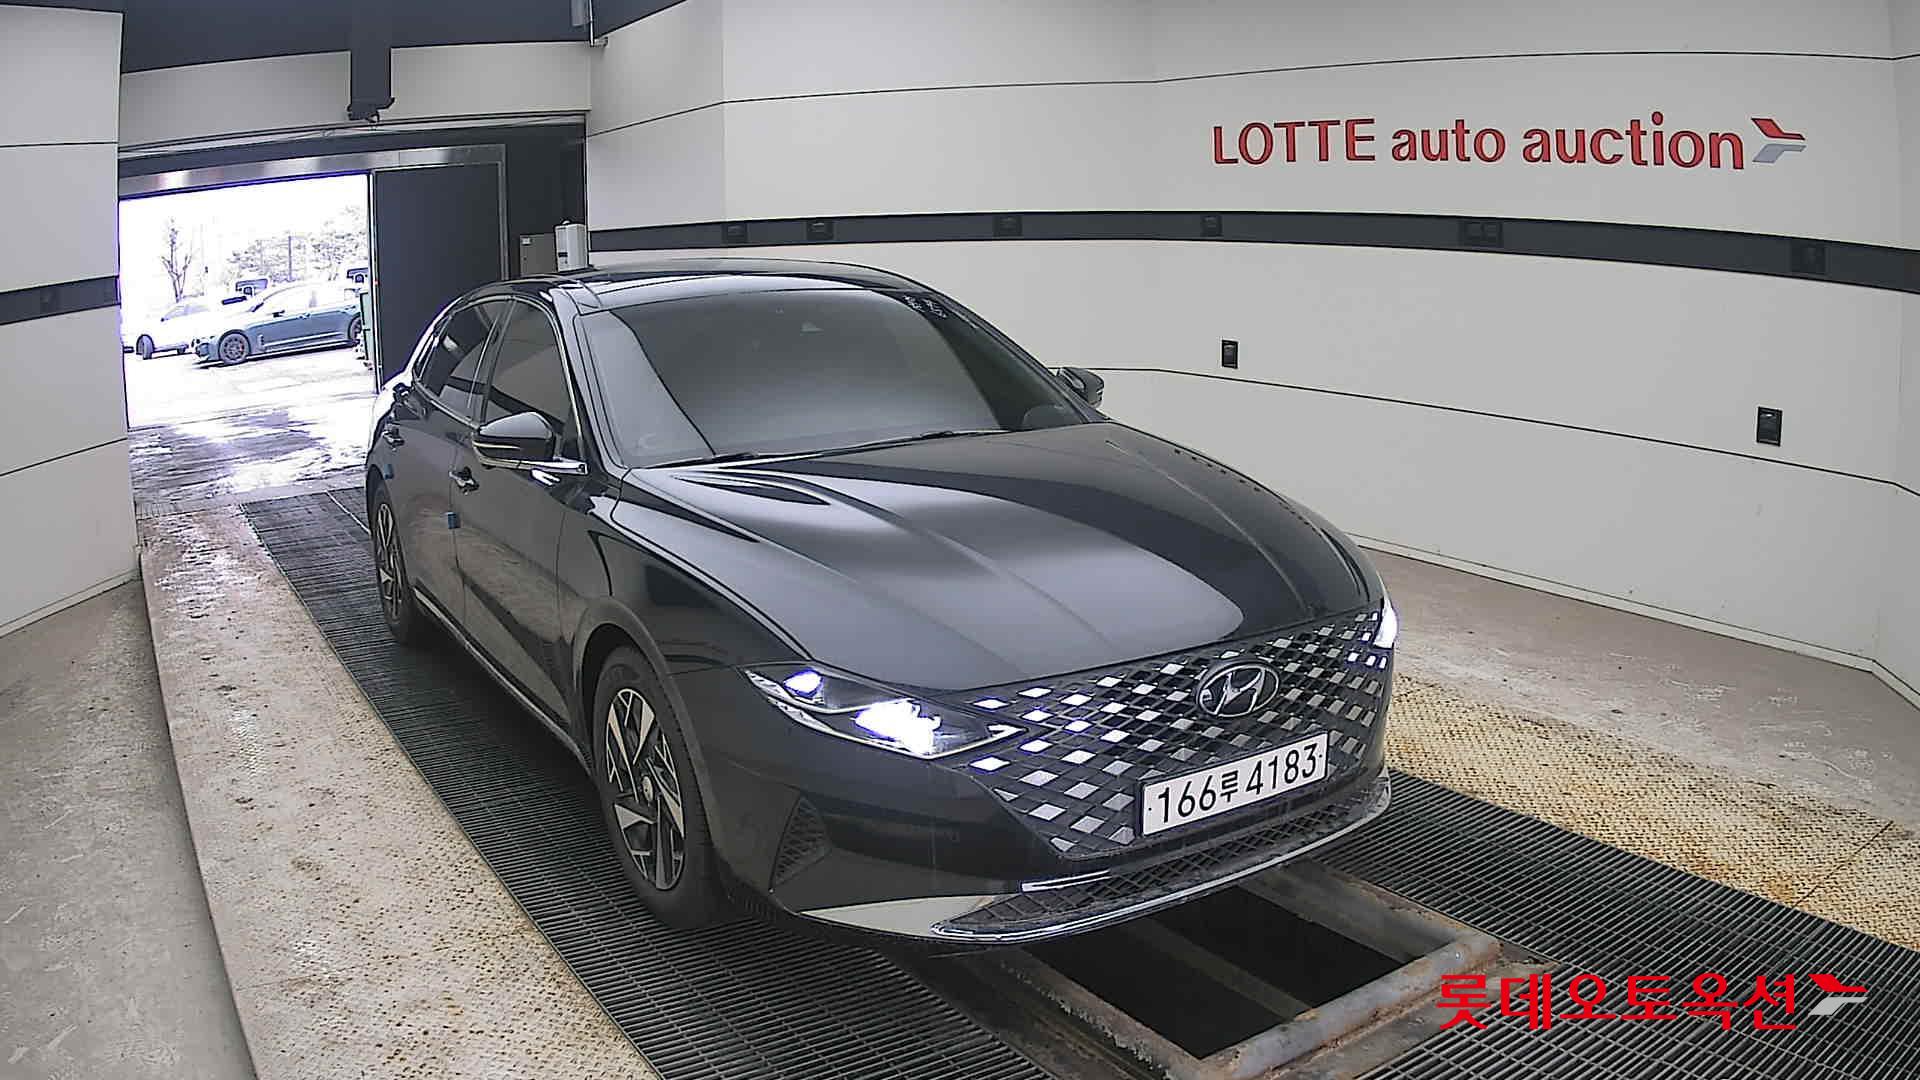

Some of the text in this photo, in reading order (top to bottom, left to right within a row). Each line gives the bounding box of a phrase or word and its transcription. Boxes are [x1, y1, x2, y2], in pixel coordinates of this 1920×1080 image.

[1213, 111, 1744, 170] LOTTE auto auction
